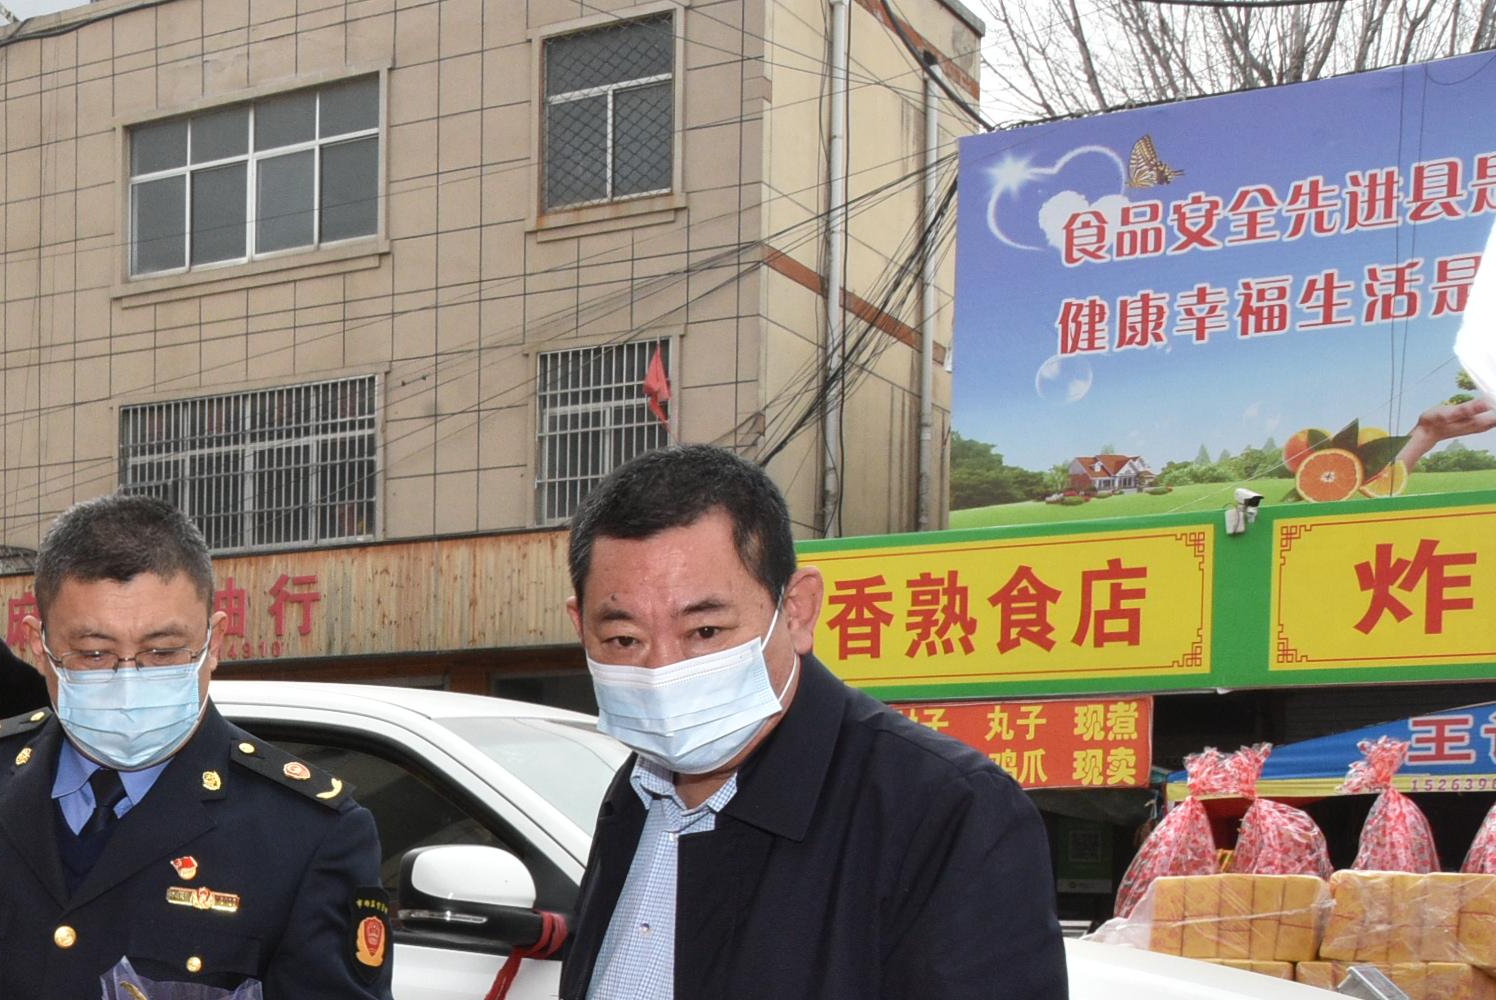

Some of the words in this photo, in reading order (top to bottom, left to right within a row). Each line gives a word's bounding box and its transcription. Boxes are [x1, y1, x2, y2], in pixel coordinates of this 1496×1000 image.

[826, 558, 1147, 661] 香熟食店
[1353, 538, 1478, 635] 炸
[985, 705, 1047, 741] 丸子
[1074, 702, 1139, 741] 现煮
[1404, 715, 1496, 766] 王
[1072, 747, 1137, 785] 现卖
